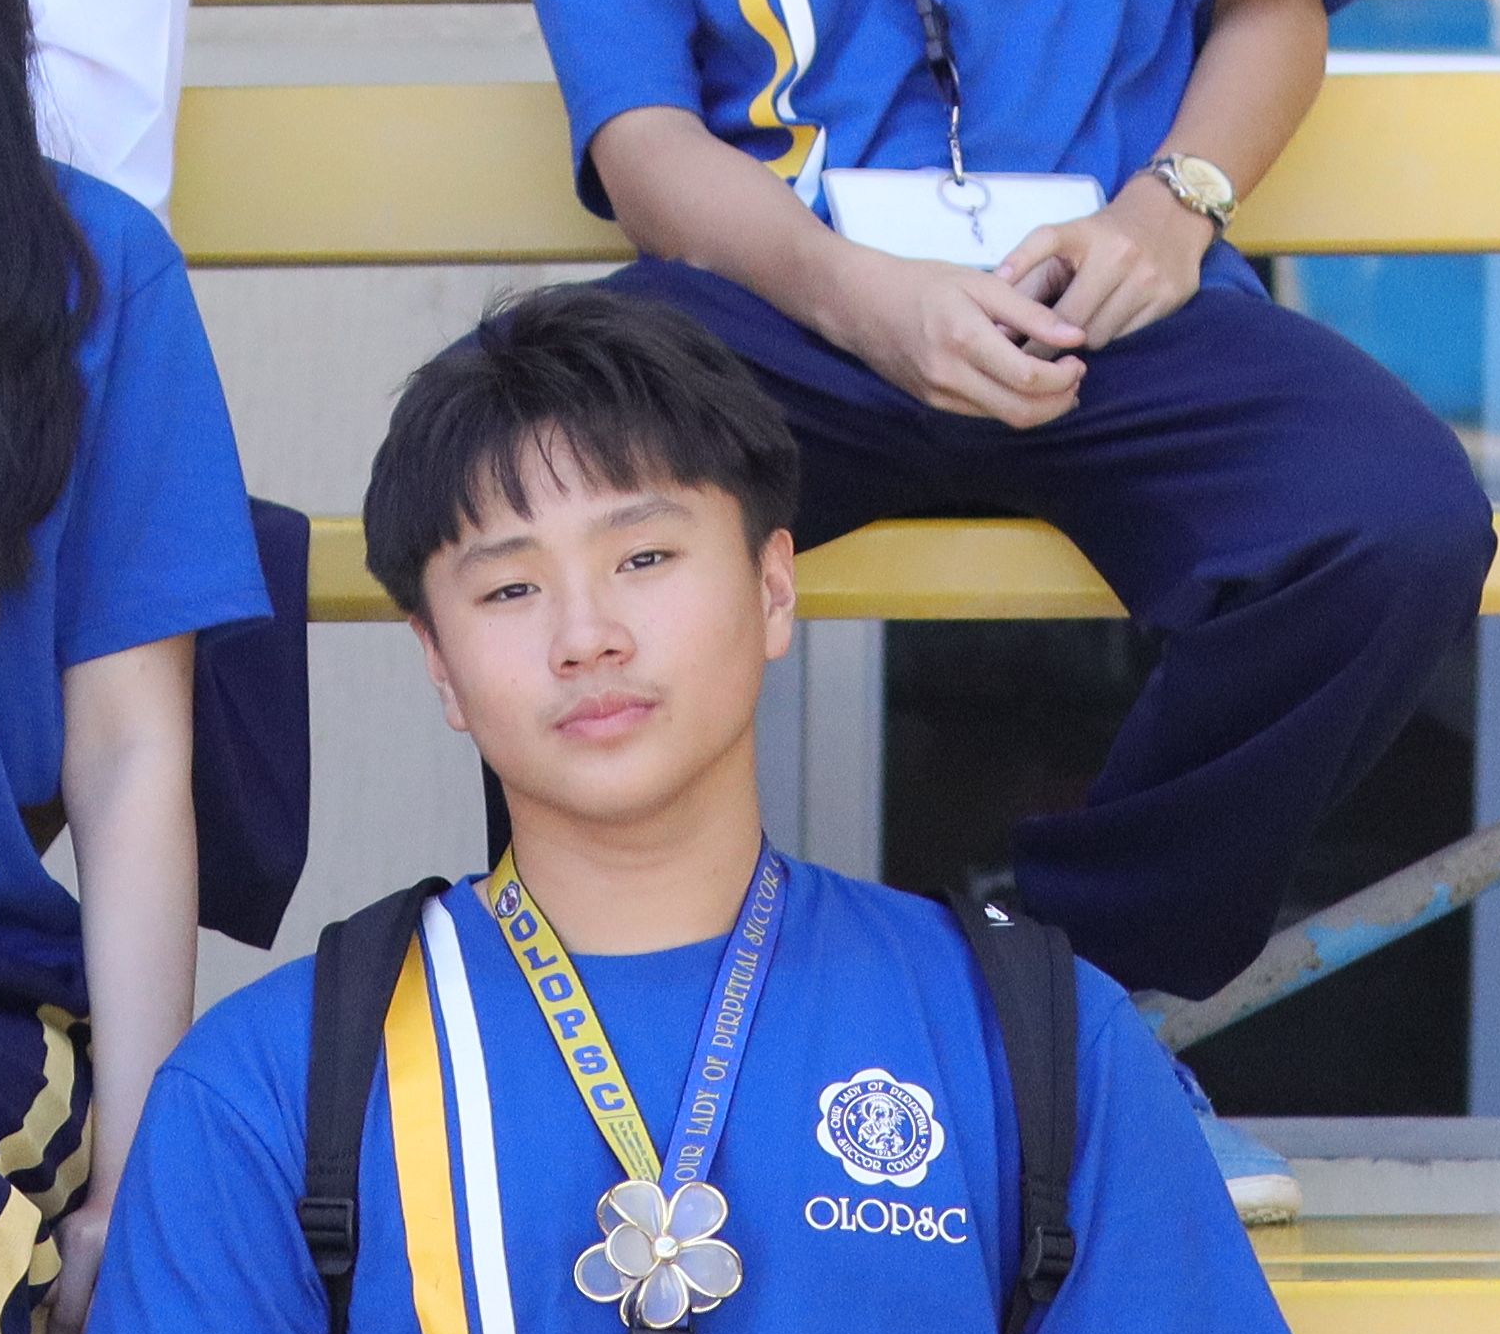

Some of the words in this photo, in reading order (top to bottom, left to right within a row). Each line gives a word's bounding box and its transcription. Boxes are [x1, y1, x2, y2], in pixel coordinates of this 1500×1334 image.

[743, 867, 779, 946] SUCCOR
[509, 910, 626, 1111] OLOPSC
[711, 948, 759, 1048] PERPETUAL
[702, 1055, 729, 1081] OF
[685, 1089, 720, 1136] LADY
[838, 1085, 863, 1104] LADY
[867, 1082, 885, 1091] OF
[674, 1144, 705, 1182] OUR
